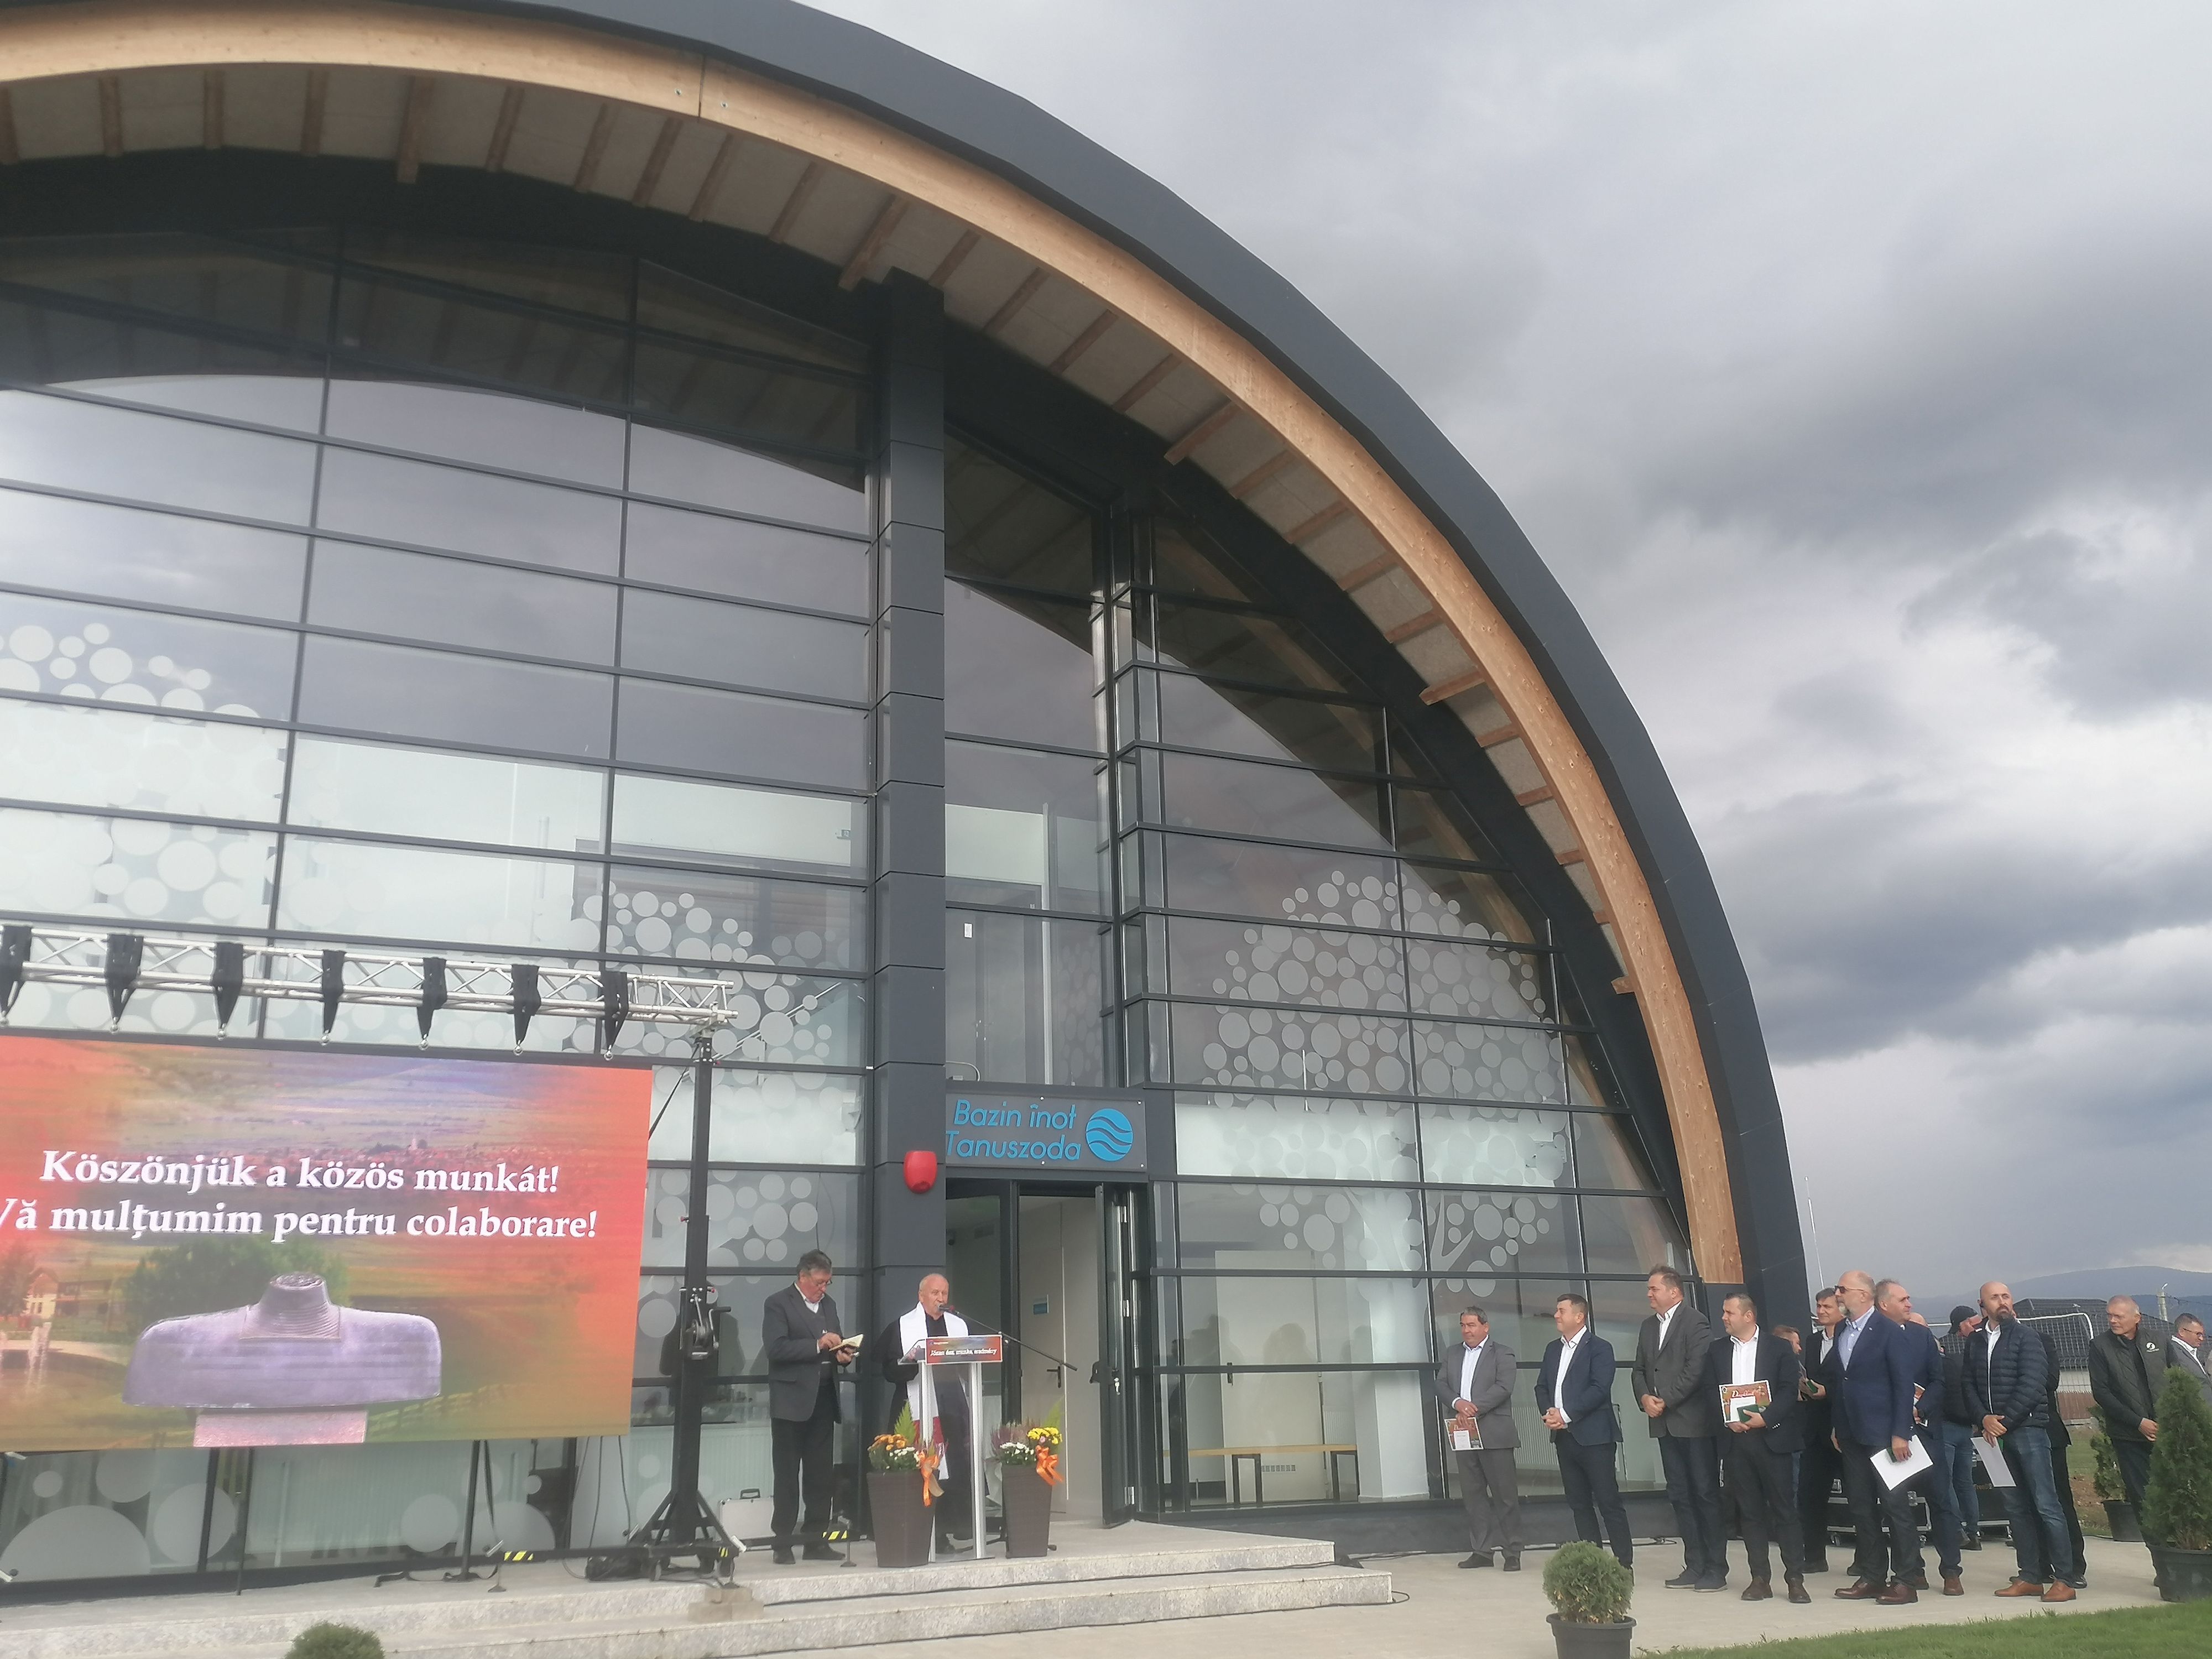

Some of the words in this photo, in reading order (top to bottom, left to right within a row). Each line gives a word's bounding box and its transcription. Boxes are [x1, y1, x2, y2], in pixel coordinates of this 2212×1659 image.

[953, 1099, 1022, 1127] Bazin
[1030, 1103, 1077, 1130] înot
[946, 1130, 1082, 1161] Tanuszoda
[39, 1150, 257, 1194] Köszönjük
[265, 1165, 288, 1187] a
[296, 1156, 404, 1190] közös
[413, 1162, 559, 1193] munkát!
[270, 1207, 397, 1244] pentru
[406, 1206, 597, 1238] colaborare!
